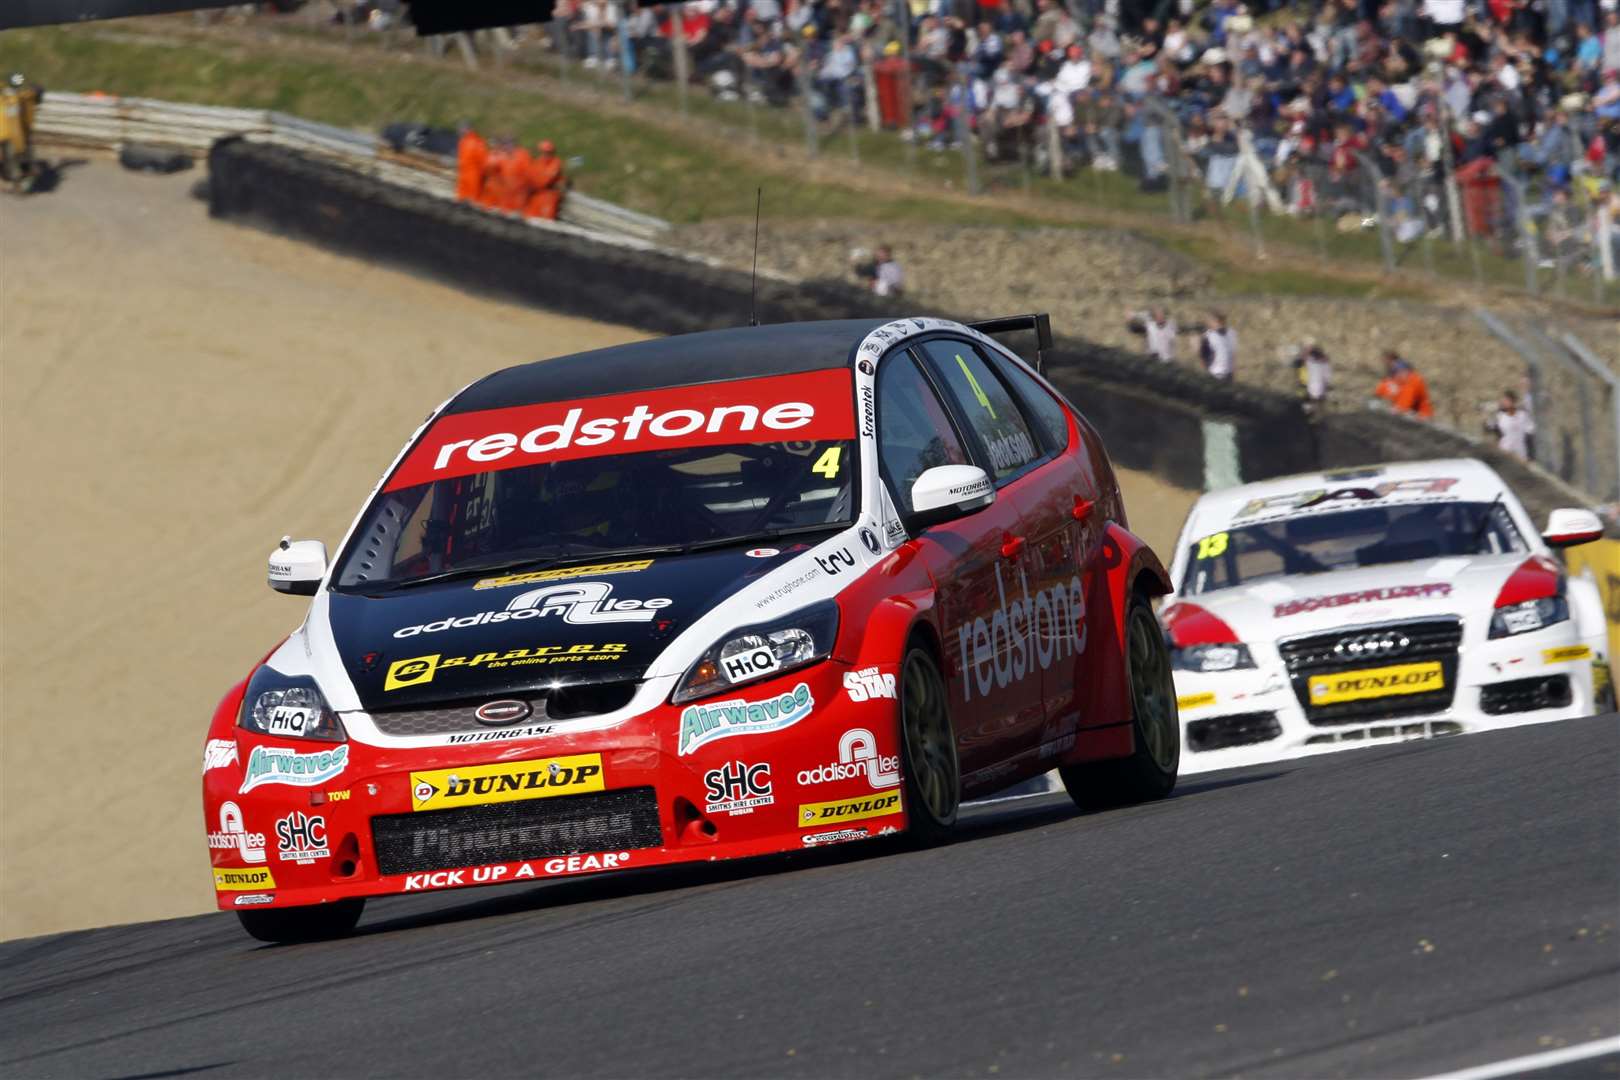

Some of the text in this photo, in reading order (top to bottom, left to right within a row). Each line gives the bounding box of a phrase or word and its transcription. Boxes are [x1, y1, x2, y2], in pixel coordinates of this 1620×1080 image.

[860, 385, 874, 440] Screentek
[432, 401, 815, 470] redstone
[811, 446, 841, 479] 4
[1196, 532, 1230, 561] 13
[813, 547, 856, 576] tru
[754, 567, 822, 609] www.truphone.com
[392, 597, 673, 639] addison lee
[958, 560, 1088, 703] redstone
[438, 643, 629, 667] spares
[487, 653, 620, 669] the online parts store
[726, 650, 775, 679] HiQ
[843, 671, 898, 702] STAR
[1334, 668, 1441, 692] DUNLOP
[271, 711, 305, 731] HiQ
[680, 685, 809, 752] Airwaves
[447, 726, 557, 744] MOTORBASE
[246, 746, 346, 785] Airwaves
[797, 754, 899, 786] addison lee
[444, 764, 600, 797] DUNLOP
[704, 761, 772, 802] SHC
[328, 790, 351, 802] TOW
[749, 796, 772, 806] CENTRE
[819, 796, 899, 818] DUNLOP
[246, 830, 266, 848] lee
[275, 811, 328, 852] SHC
[224, 871, 268, 885] DUNLOP
[404, 870, 465, 891] KICK
[472, 866, 507, 882] UP
[514, 863, 535, 878] A
